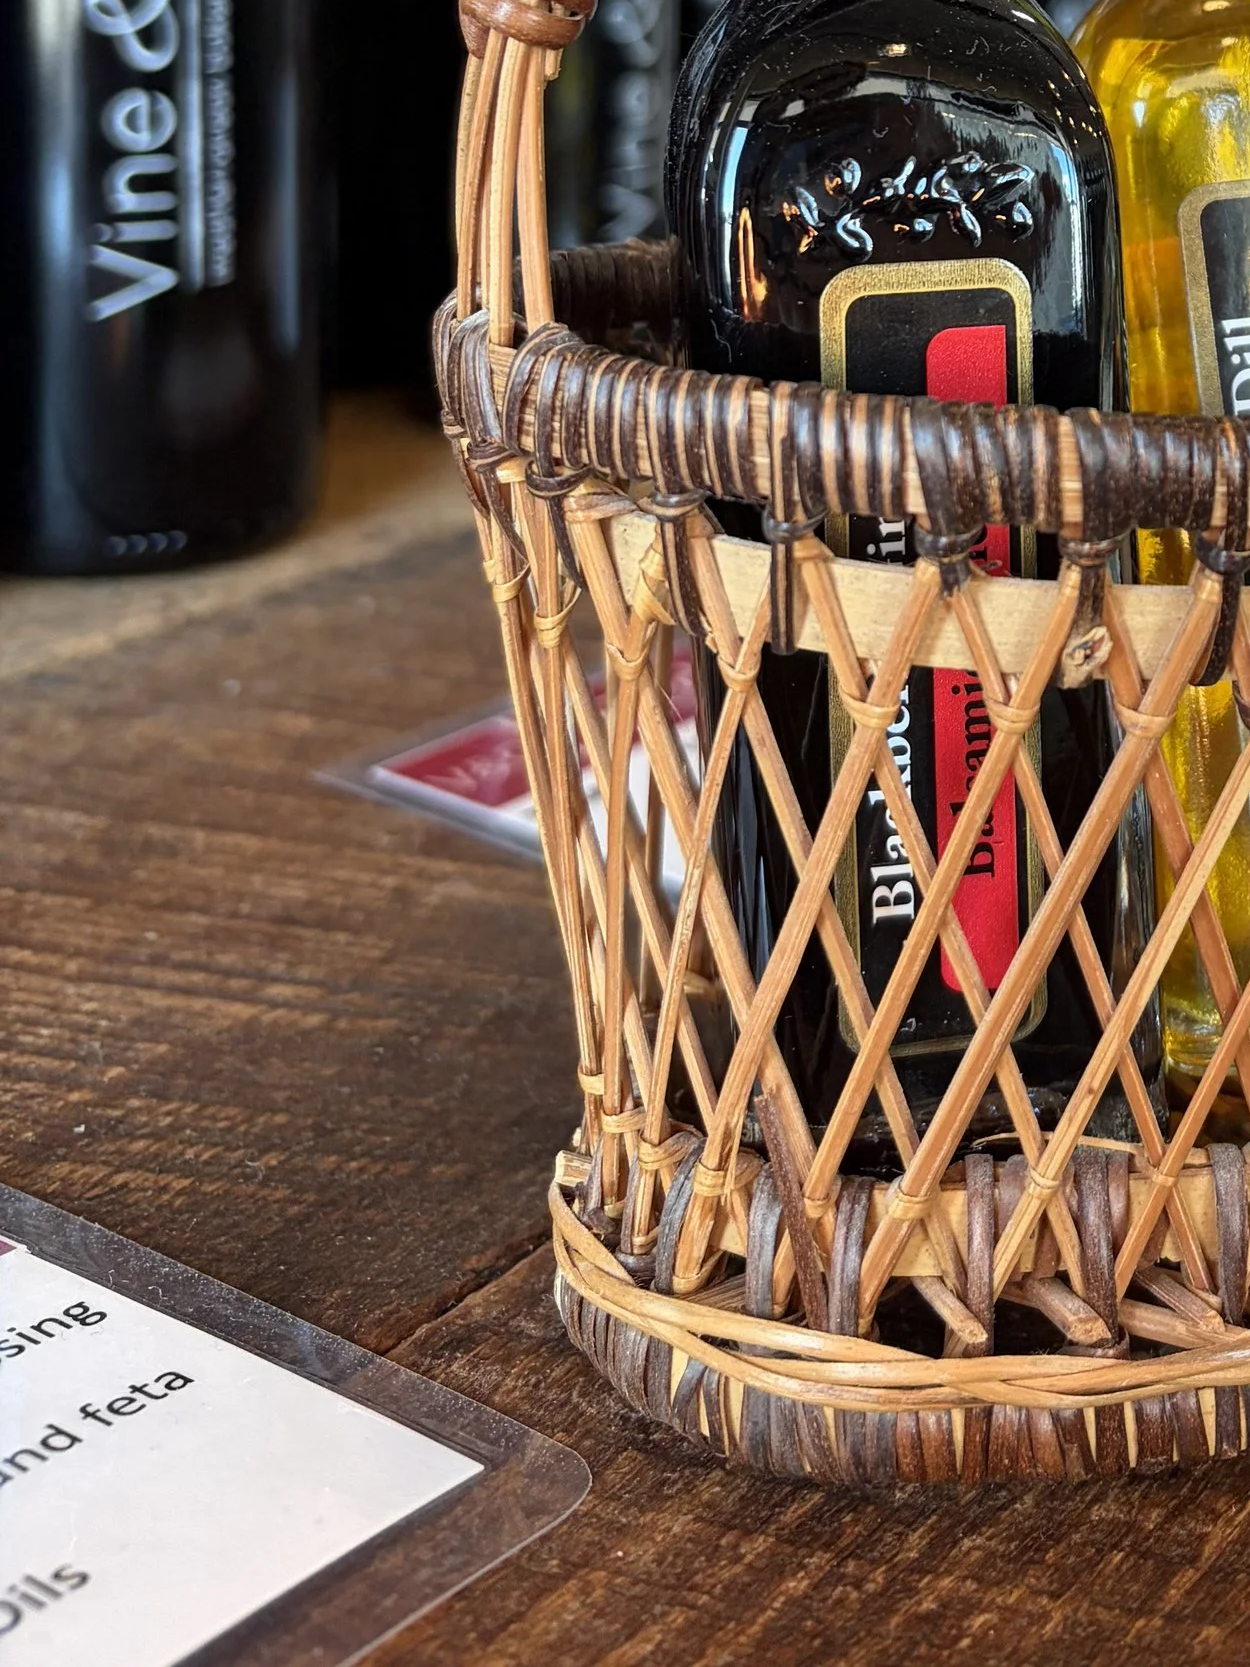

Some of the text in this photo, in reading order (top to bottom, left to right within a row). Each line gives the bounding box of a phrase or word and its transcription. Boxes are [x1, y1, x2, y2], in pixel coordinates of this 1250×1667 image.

[85, 86, 179, 323] Vine
[866, 680, 916, 924] Blakbe
[948, 668, 996, 880] Blami
[0, 1301, 108, 1360] sing
[79, 1371, 195, 1427] feta
